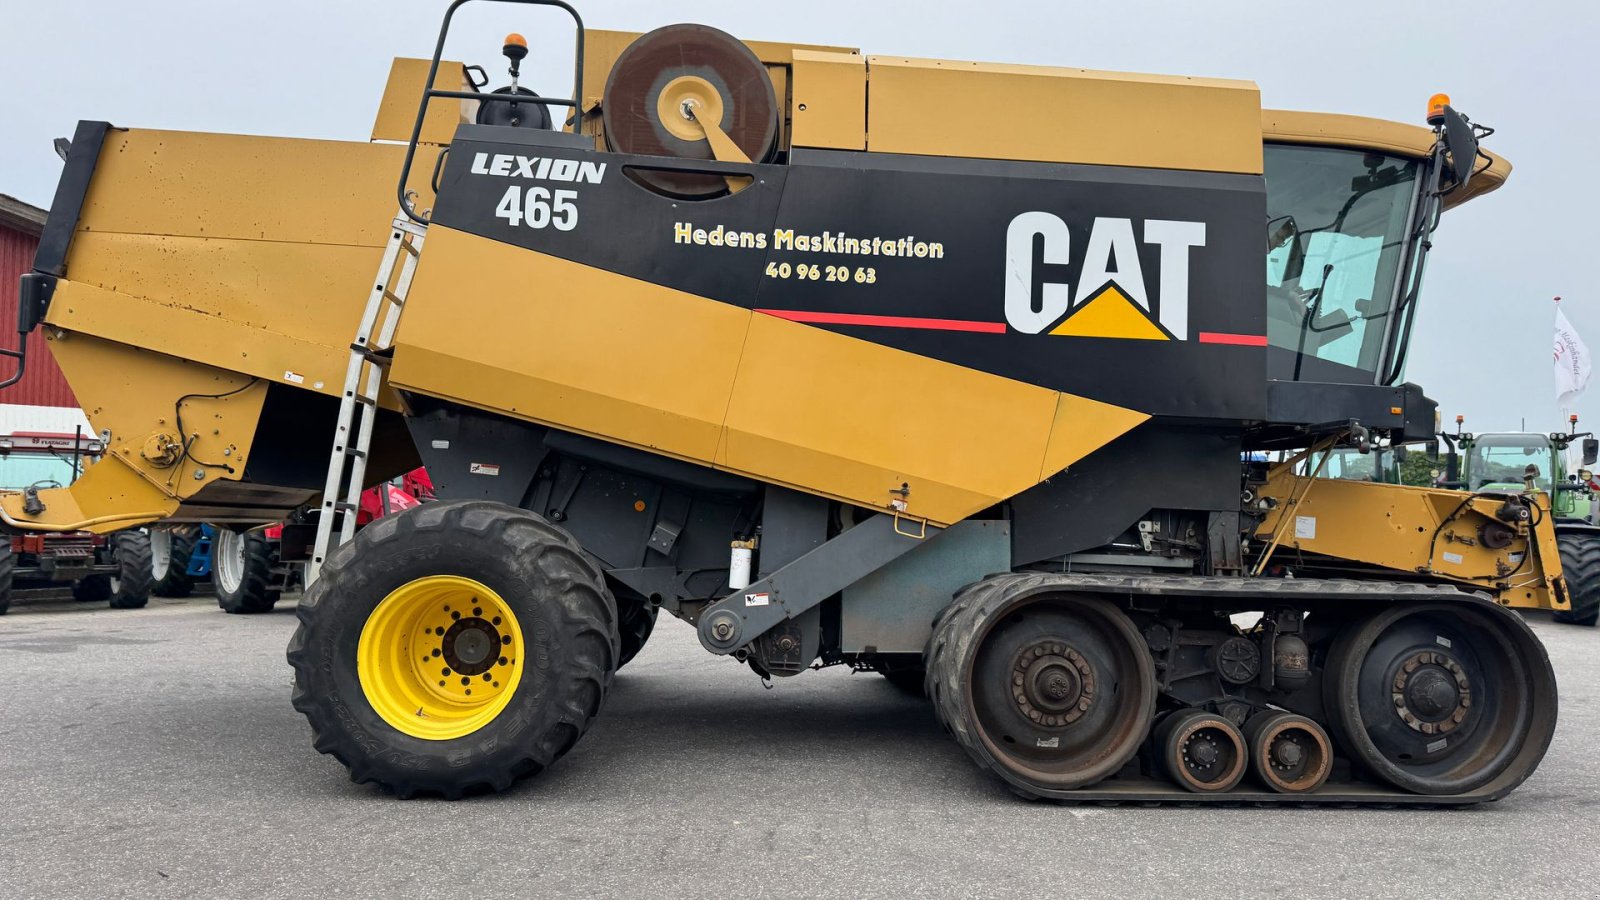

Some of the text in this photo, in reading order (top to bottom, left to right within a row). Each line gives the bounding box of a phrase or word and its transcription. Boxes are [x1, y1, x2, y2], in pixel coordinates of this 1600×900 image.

[471, 152, 607, 184] LEXION
[495, 185, 578, 231] 465
[673, 222, 944, 259] Hedens Maskinstation
[765, 262, 877, 284] 40 96 20 63
[1004, 211, 1206, 340] CAT
